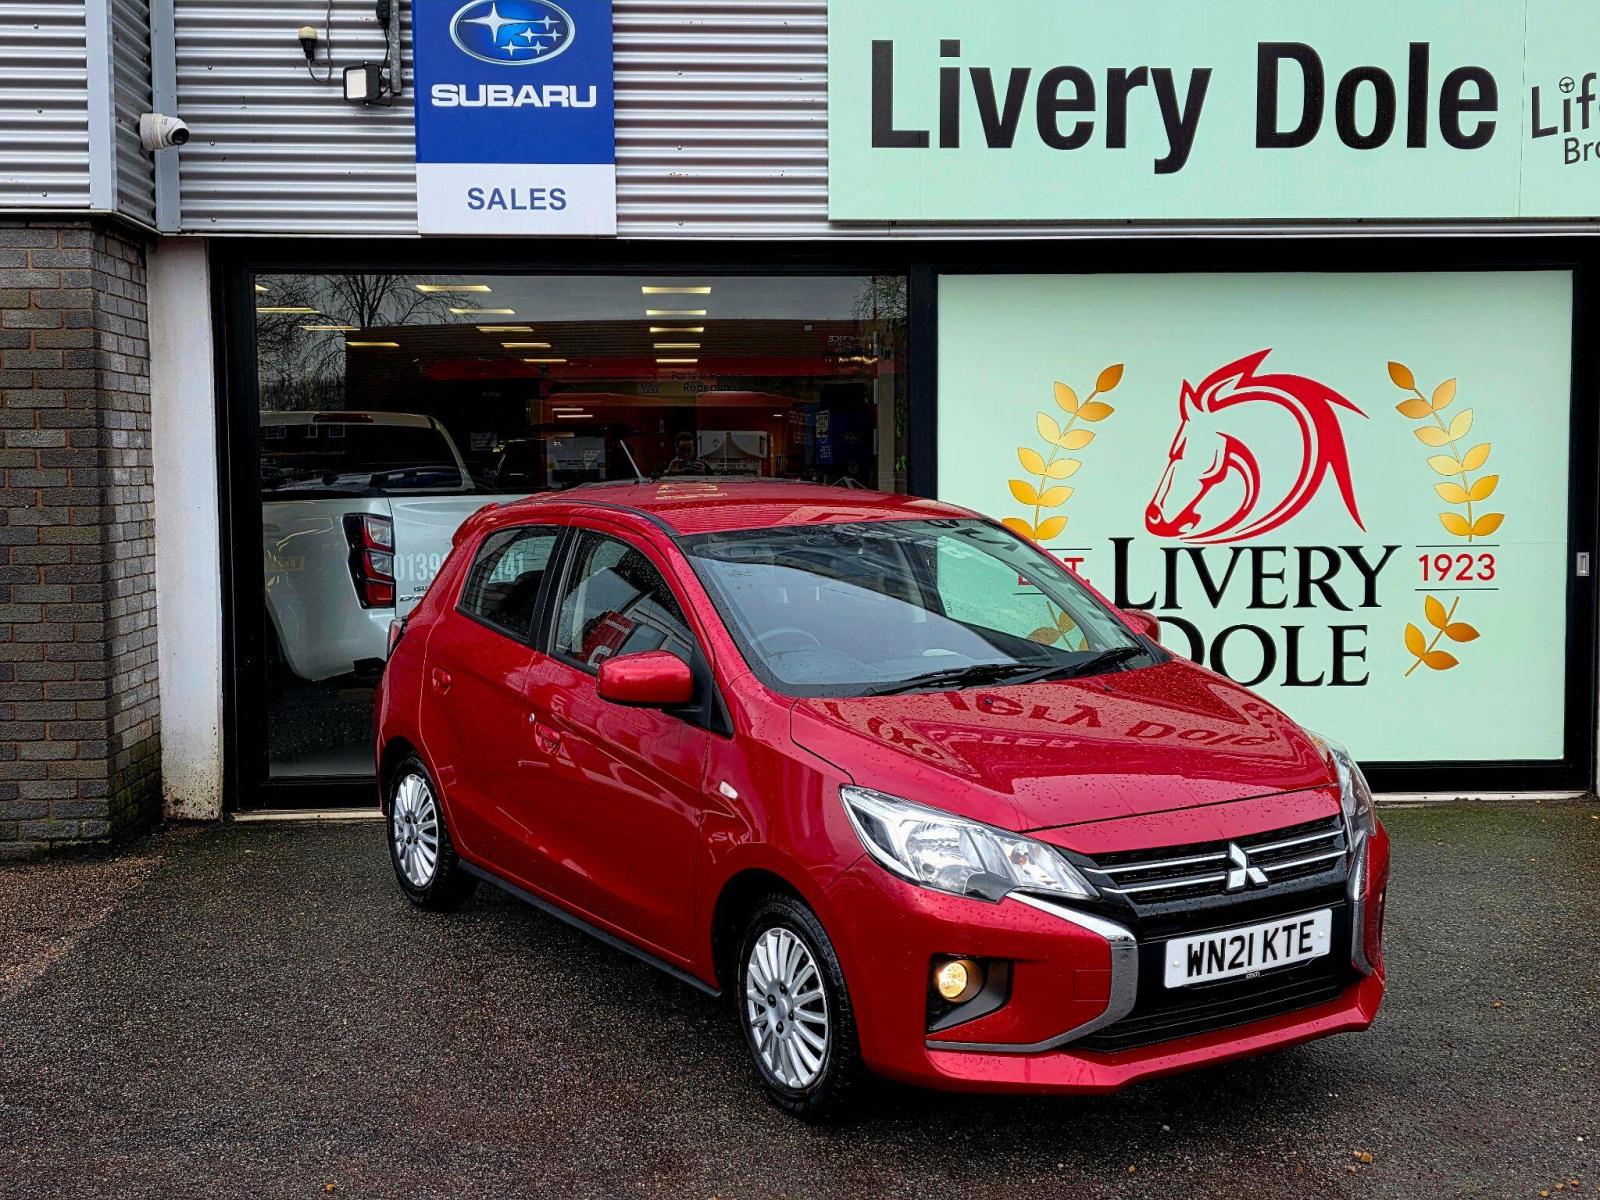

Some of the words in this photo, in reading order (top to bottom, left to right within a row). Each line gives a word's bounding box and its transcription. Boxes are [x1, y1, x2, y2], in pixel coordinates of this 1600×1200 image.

[431, 83, 597, 108] SUBARU
[871, 39, 1213, 174] Livery
[1255, 41, 1499, 150] Dole
[1531, 72, 1600, 139] Lif
[466, 187, 567, 211] SALES
[1108, 537, 1402, 611] LIVERY
[1418, 553, 1496, 582] 1923
[1187, 933, 1255, 977] WN21
[1262, 919, 1315, 963] KTE
